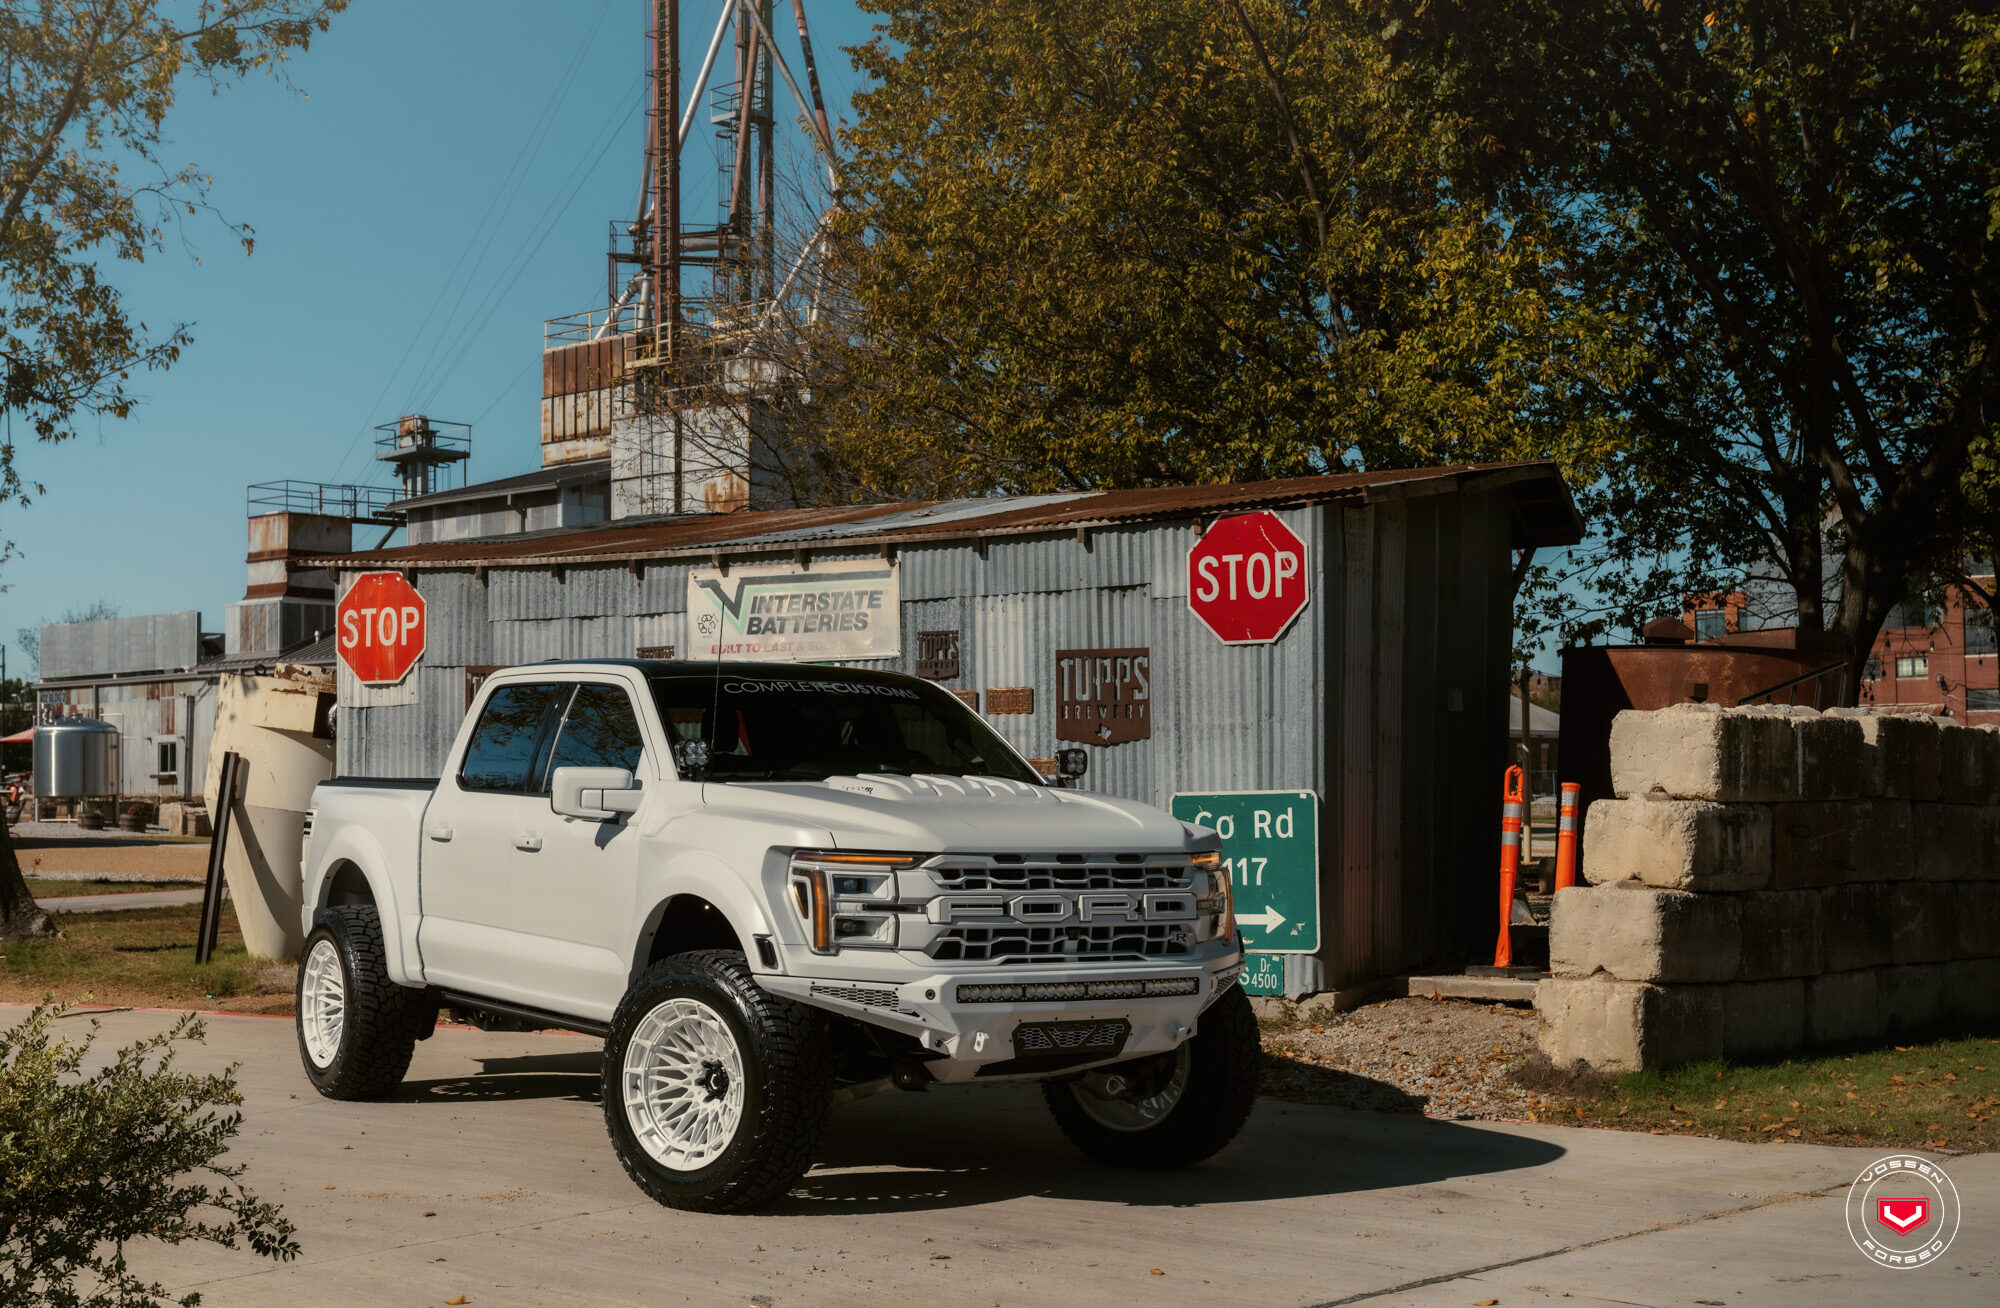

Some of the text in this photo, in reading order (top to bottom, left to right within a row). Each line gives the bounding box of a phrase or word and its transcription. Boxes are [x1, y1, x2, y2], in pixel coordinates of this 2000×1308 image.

[1196, 550, 1299, 603] STOP
[750, 590, 884, 615] INTERSTATE
[342, 606, 420, 649] STOP
[746, 612, 869, 635] BATTERIES
[745, 643, 760, 653] TO
[763, 641, 793, 653] LAST
[917, 634, 960, 660] TUPPS
[724, 681, 920, 700] COMPLETECUSTOMS
[1060, 655, 1149, 702] TUPPS
[1061, 703, 1145, 720] BREWERY
[1253, 807, 1294, 839] Rd
[927, 893, 1197, 924] FORD
[1251, 972, 1278, 989] 4500
